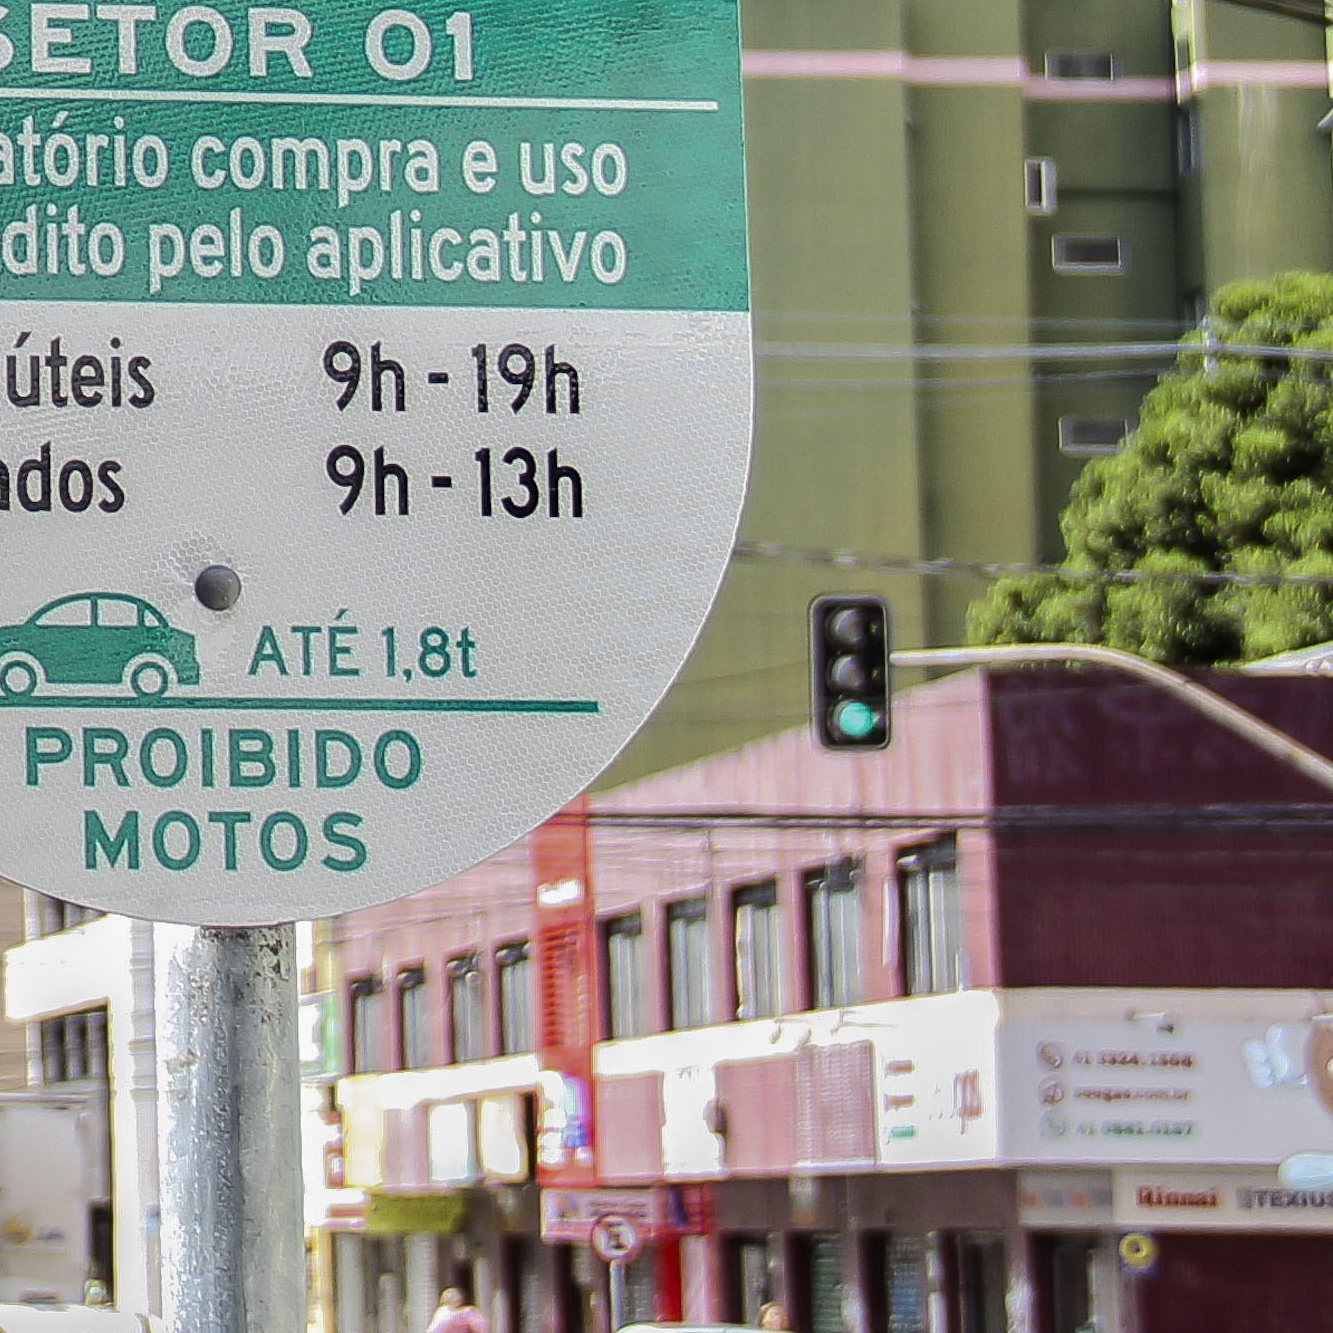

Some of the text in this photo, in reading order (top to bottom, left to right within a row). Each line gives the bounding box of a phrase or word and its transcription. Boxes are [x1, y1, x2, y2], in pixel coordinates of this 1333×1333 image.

[191, 131, 439, 207] compra
[461, 139, 497, 193] e
[520, 142, 626, 196] uso
[150, 209, 283, 292] pelo
[307, 211, 626, 295] aplicativo
[7, 333, 154, 407] úteis
[323, 342, 405, 412] 9h
[473, 345, 580, 414] 19h
[327, 445, 408, 515] 9h
[475, 447, 582, 518] 13h
[247, 609, 478, 683] ATÉ 1,8t
[26, 727, 423, 790] PROIBIDO
[85, 811, 368, 872] MOTOS
